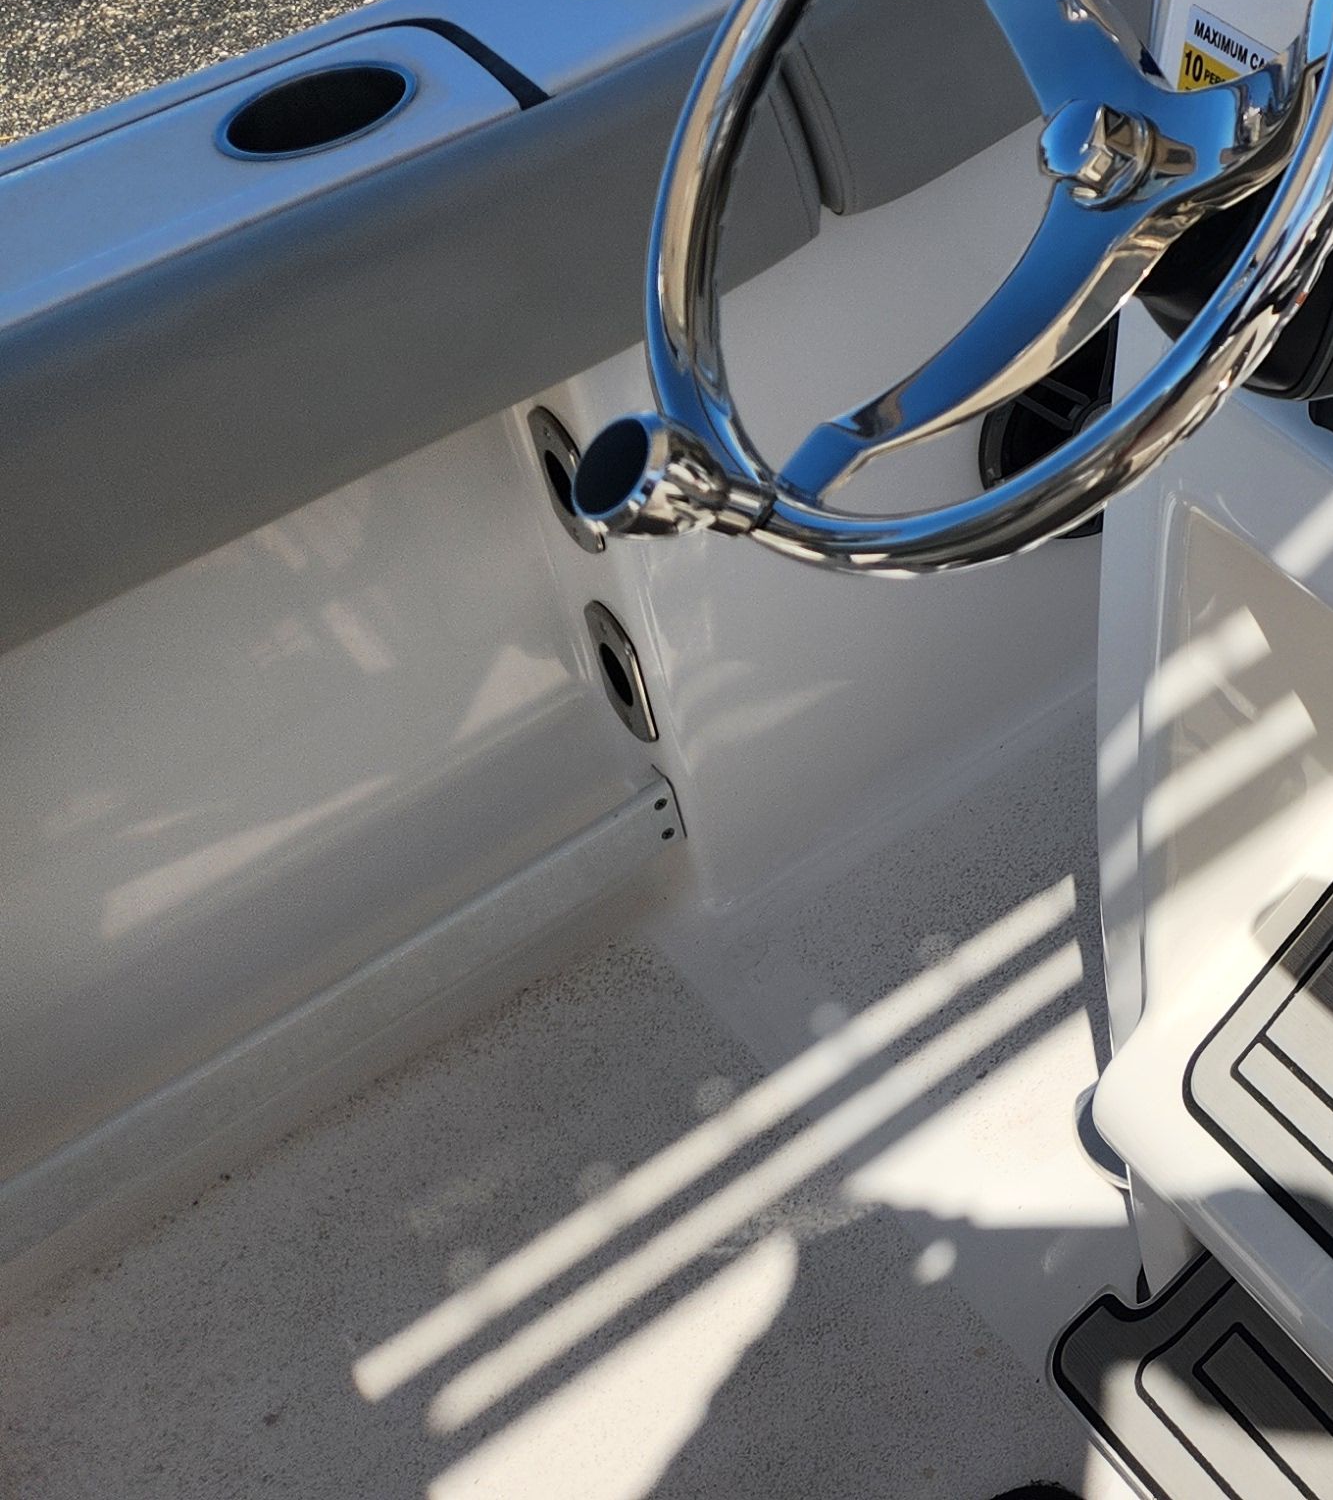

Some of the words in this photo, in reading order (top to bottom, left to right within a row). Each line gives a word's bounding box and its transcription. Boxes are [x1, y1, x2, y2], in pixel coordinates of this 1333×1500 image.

[1194, 19, 1248, 65] MAXIMUM
[1250, 53, 1265, 70] CA
[1185, 50, 1204, 82] 10
